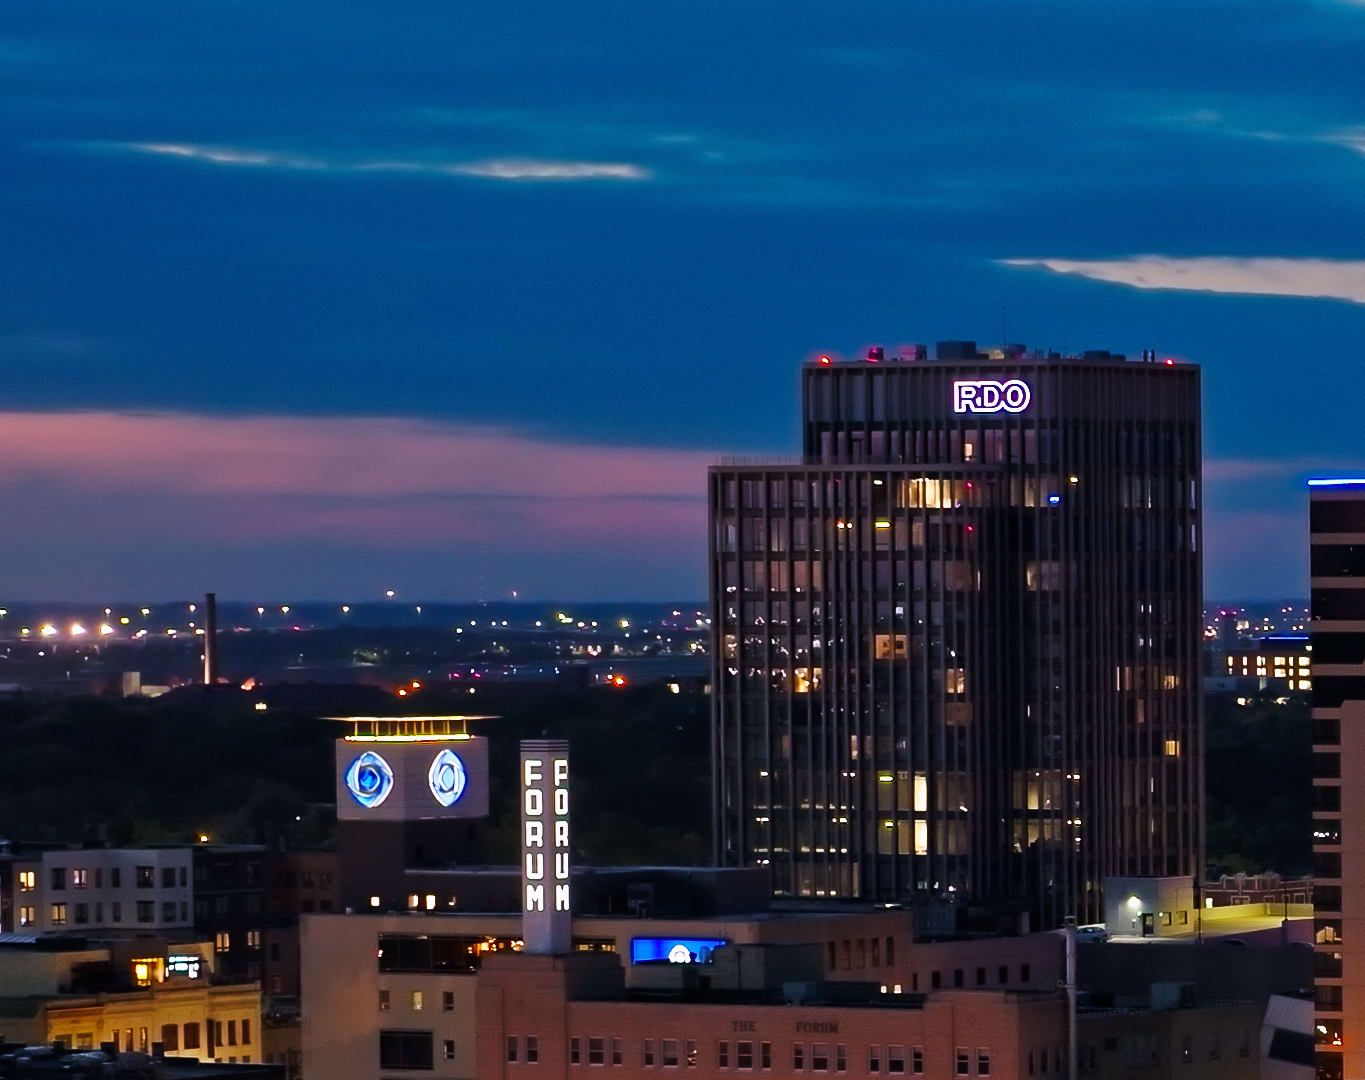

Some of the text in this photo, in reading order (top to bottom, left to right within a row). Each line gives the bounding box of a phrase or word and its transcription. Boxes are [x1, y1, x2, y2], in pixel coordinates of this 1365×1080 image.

[953, 379, 1031, 414] RDO
[524, 759, 544, 912] FORUM
[553, 759, 570, 912] FORUM
[731, 1020, 839, 1034] THE FORUM
